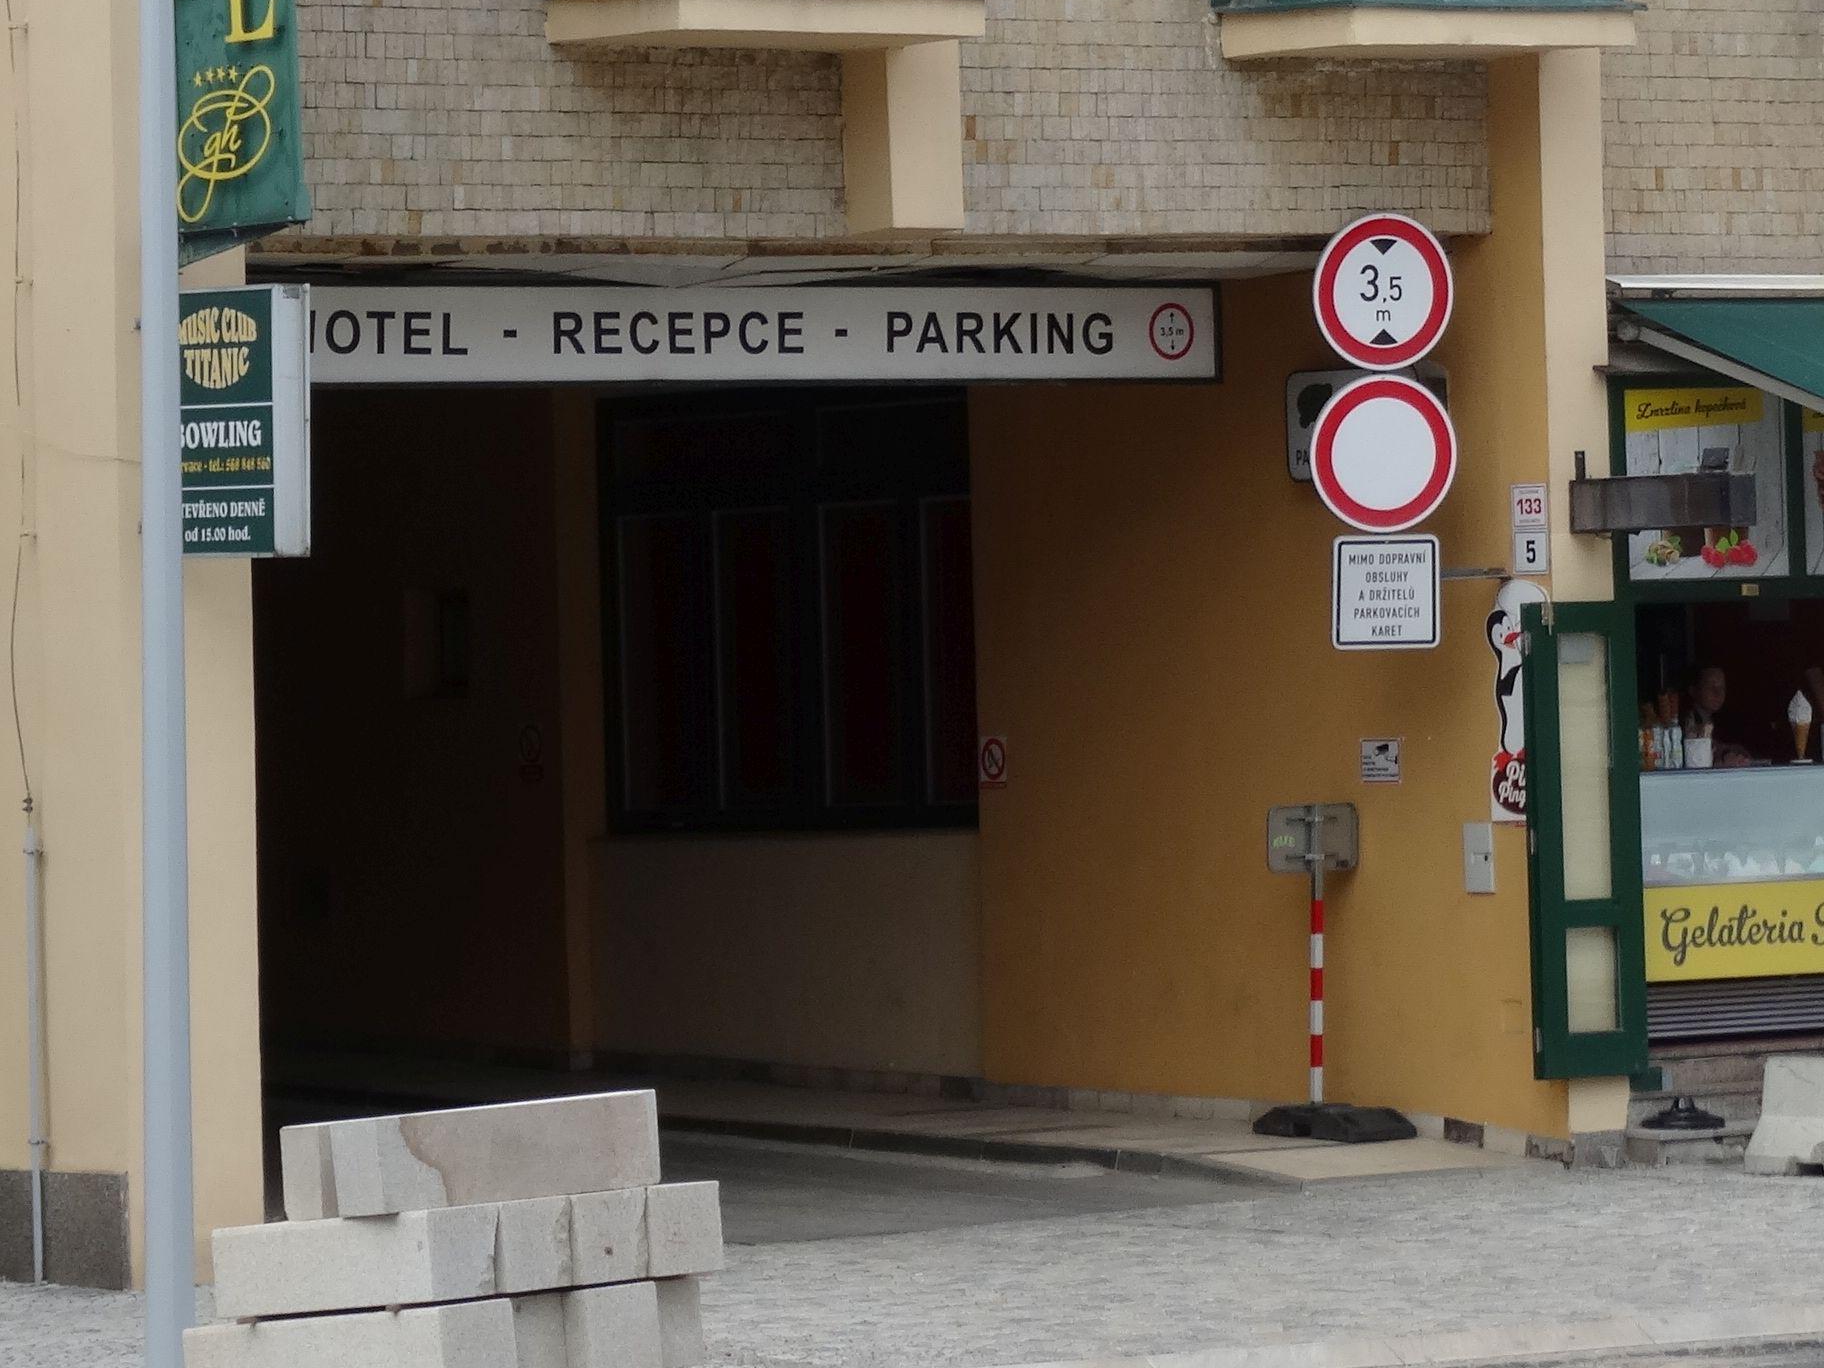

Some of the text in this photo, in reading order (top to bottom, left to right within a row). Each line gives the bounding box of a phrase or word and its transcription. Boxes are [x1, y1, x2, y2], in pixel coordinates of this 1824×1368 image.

[1359, 264, 1402, 304] 3,5
[1375, 307, 1391, 322] m
[178, 306, 257, 345] MUSIC CLUB
[310, 310, 468, 355] OTEL
[553, 311, 804, 355] RECEPCE
[886, 310, 1114, 356] PARKING
[183, 346, 250, 389] TITANIC
[182, 498, 266, 519] TEVŘENO DENNĚ
[1516, 498, 1542, 515] 133
[184, 527, 198, 542] od
[1348, 549, 1427, 565] MIMO DOPRAVNÍ
[1525, 539, 1536, 564] 5
[1365, 572, 1409, 583] OBSLUHY
[1358, 589, 1365, 601] A
[1353, 604, 1421, 620] PARKOVACÍCH
[1371, 625, 1403, 637] KARET
[1498, 781, 1526, 808] Ping
[1660, 904, 1806, 966] Gelateria
